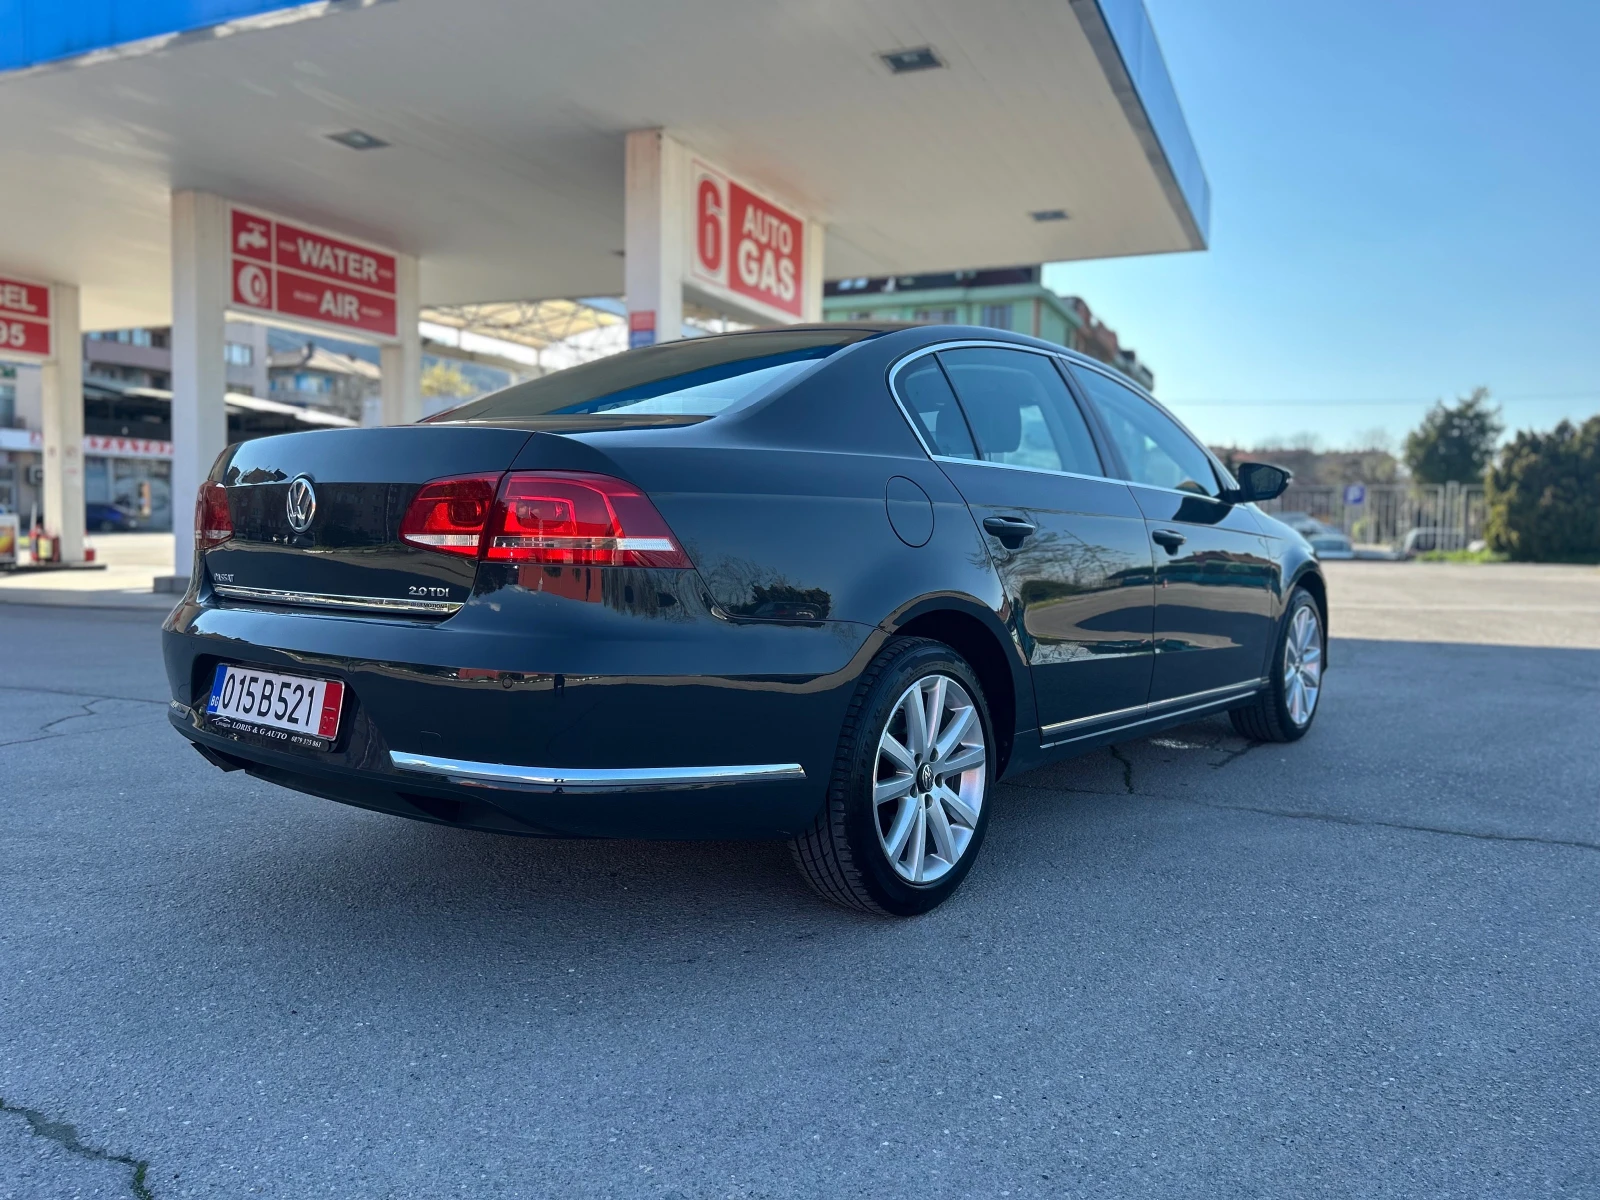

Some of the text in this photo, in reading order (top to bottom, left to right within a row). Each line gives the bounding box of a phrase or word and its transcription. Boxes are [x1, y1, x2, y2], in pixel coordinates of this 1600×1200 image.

[697, 179, 722, 271] 6
[742, 204, 793, 256] AUTO
[296, 237, 379, 284] WATER
[737, 239, 796, 302] GAS
[318, 289, 360, 322] AIR
[428, 587, 450, 597] TDI
[210, 695, 220, 708] BG
[222, 673, 316, 727] 015B521
[232, 722, 252, 732] LORIS
[266, 729, 288, 740] AUTO
